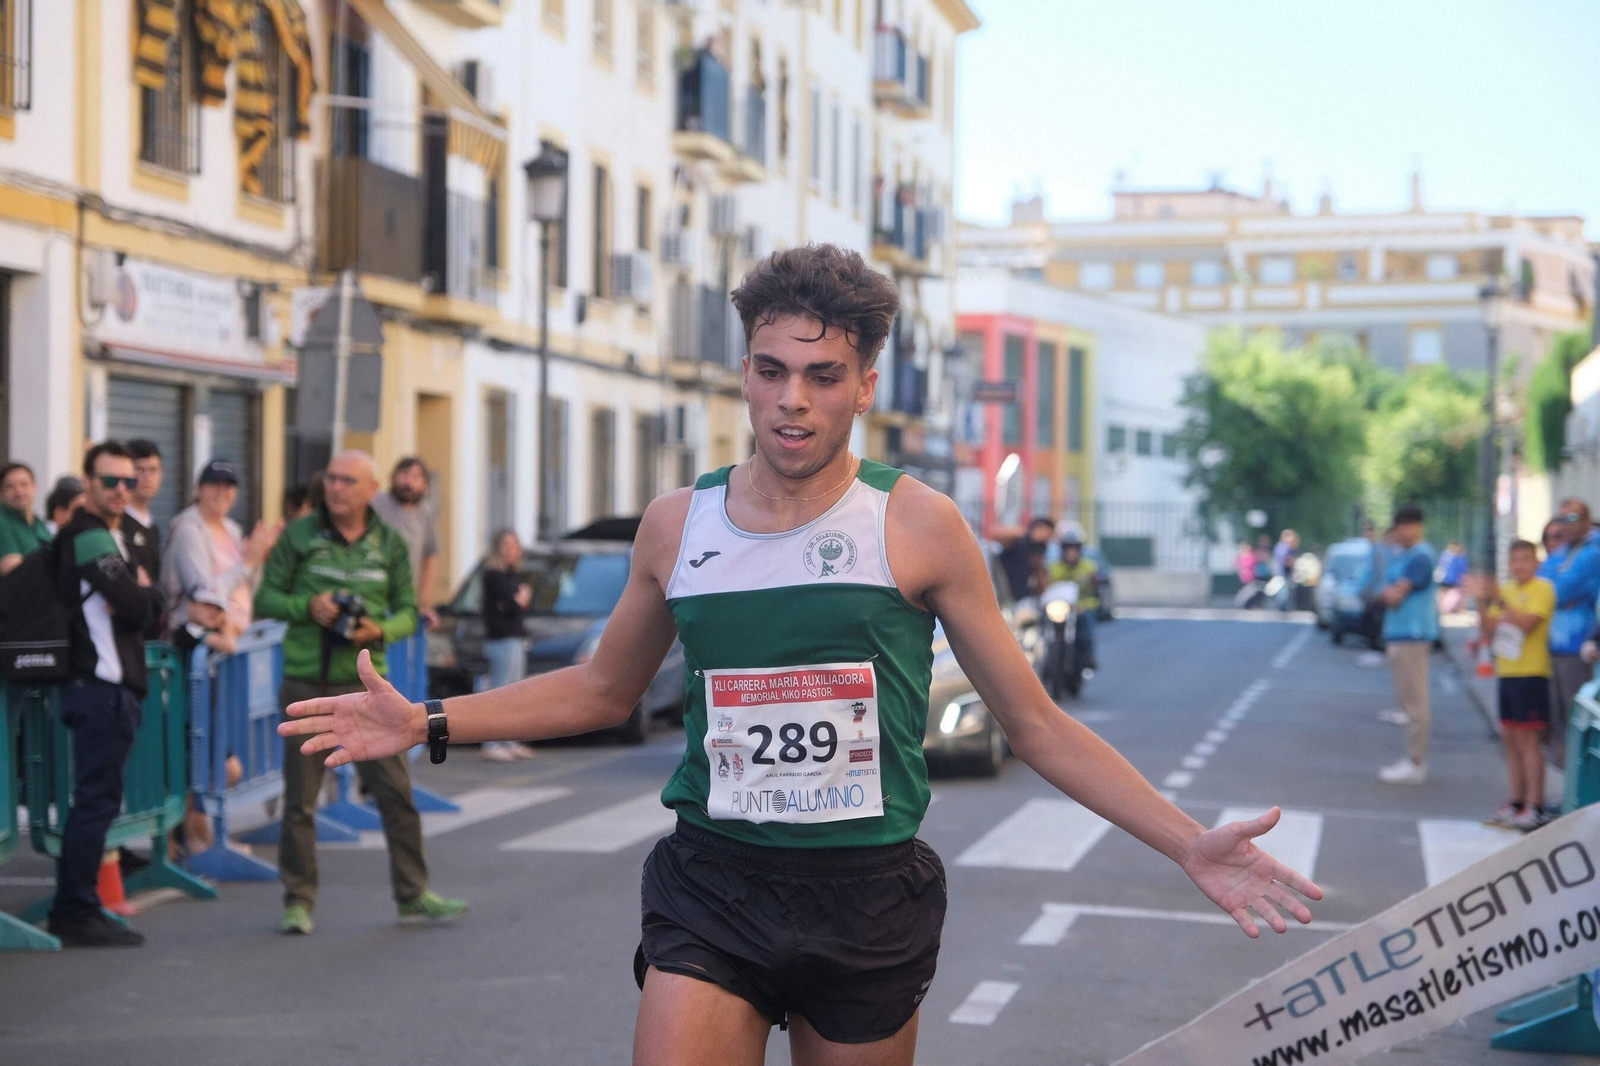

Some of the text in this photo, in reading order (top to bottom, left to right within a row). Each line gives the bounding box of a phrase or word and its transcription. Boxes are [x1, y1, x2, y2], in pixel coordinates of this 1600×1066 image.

[816, 533, 845, 541] ATLETISMO
[714, 673, 868, 692] XLI CARRERA MARÍA AUXILIADORA.
[740, 687, 835, 704] MEMORIAL KIKO PASTOR.
[747, 721, 838, 766] 289
[1252, 905, 1600, 1066] www.masatletismo.co
